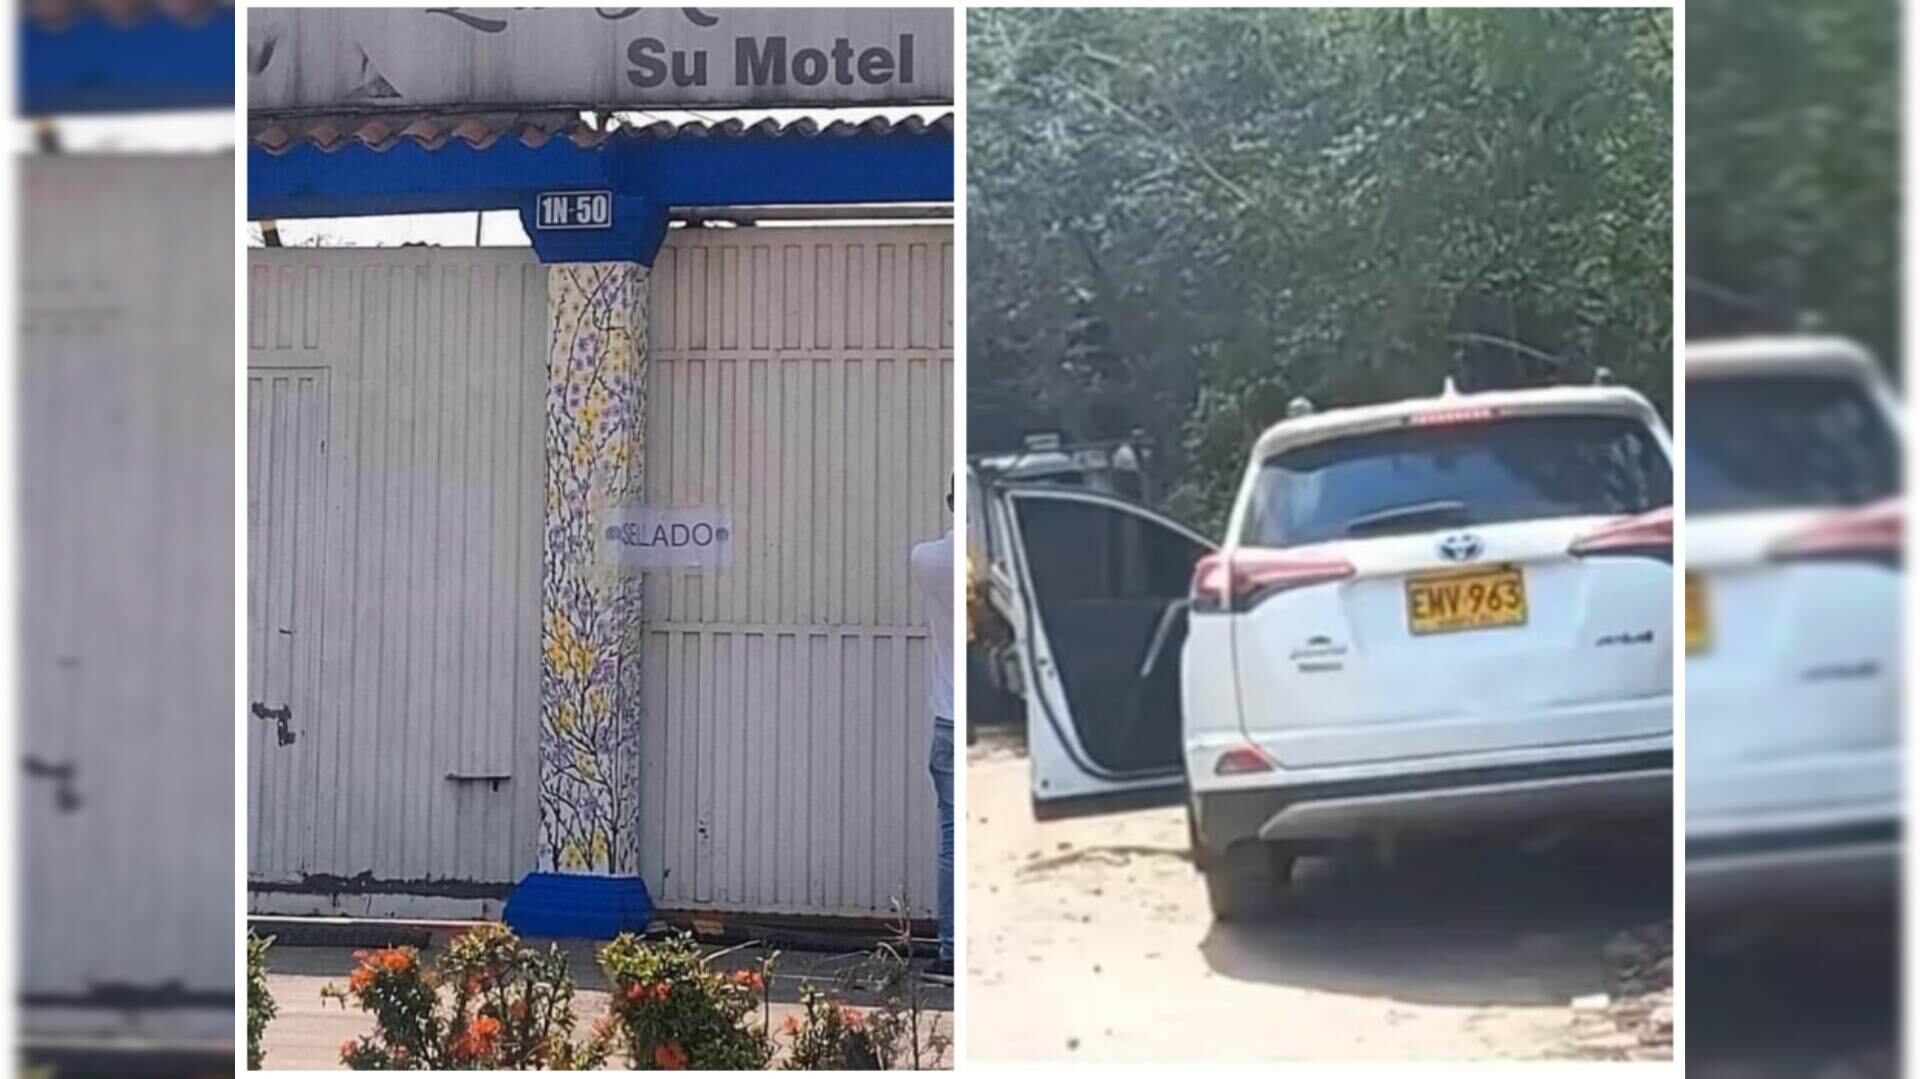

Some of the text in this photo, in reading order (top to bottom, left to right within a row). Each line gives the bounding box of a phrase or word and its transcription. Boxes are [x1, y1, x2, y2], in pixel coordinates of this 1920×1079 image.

[627, 34, 914, 88] Su Motel
[542, 195, 607, 224] 1N-50
